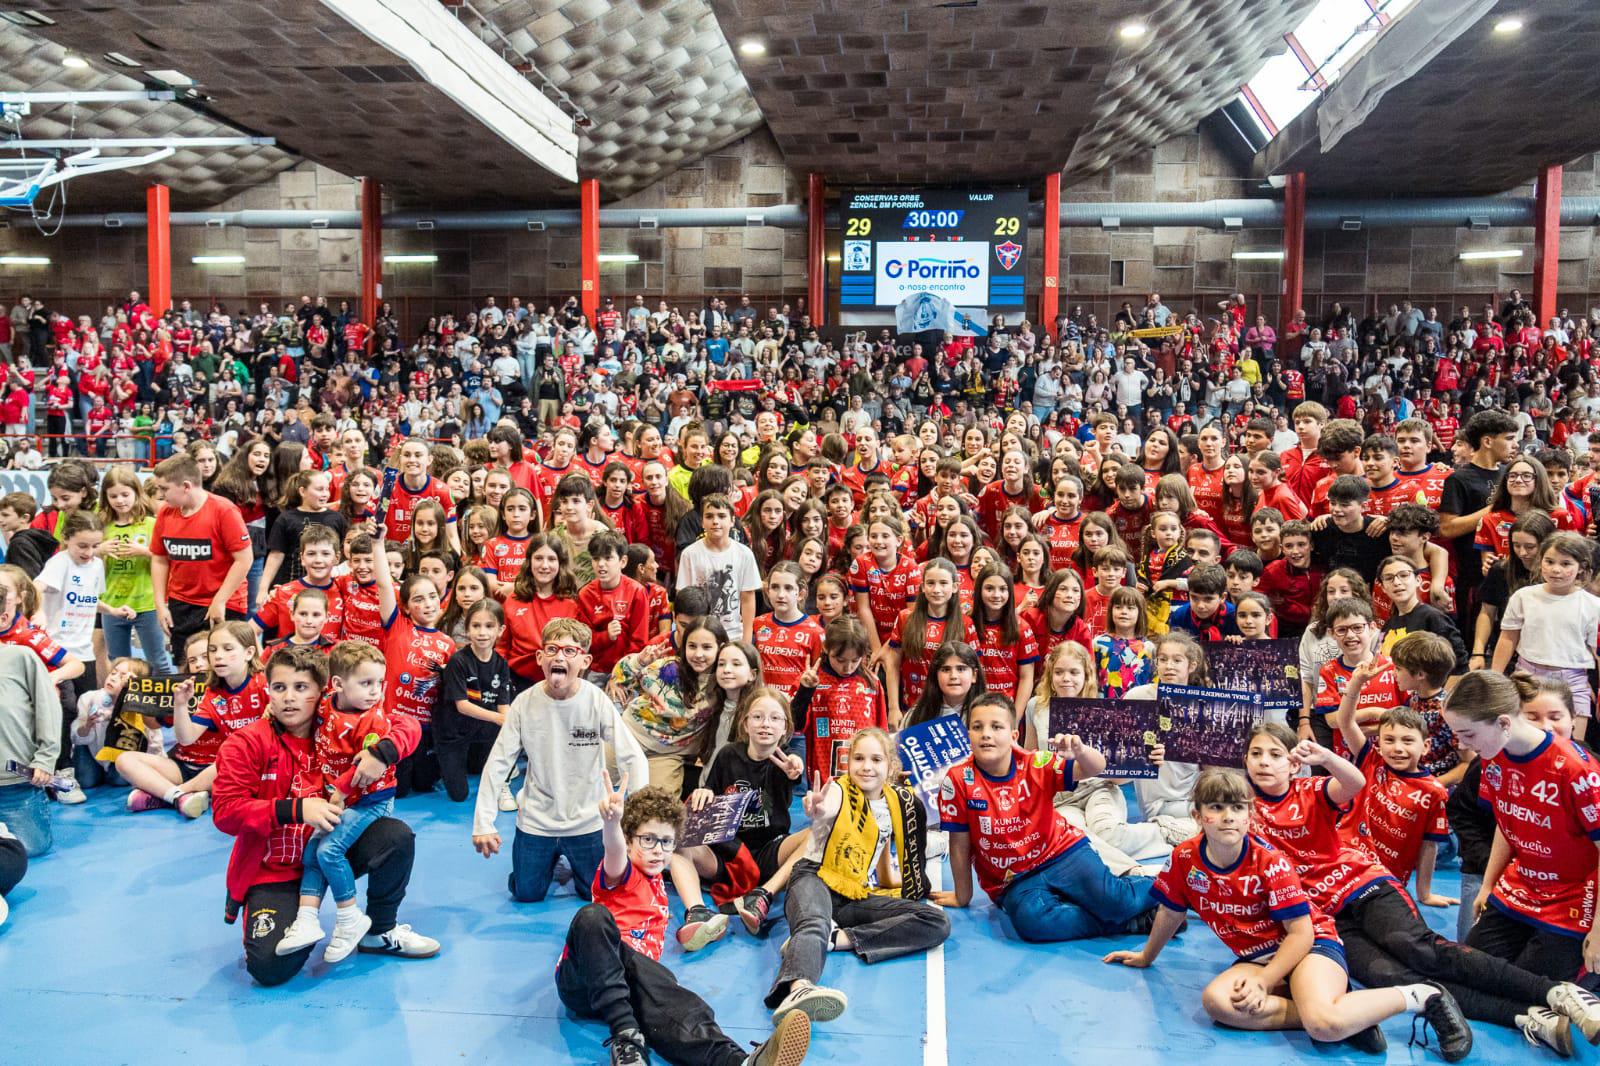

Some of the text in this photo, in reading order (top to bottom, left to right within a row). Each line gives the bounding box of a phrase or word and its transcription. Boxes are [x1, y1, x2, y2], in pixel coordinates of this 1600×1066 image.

[850, 201, 878, 209] ZENDAL
[891, 200, 924, 208] PORRIÑO
[846, 218, 872, 236] 29
[909, 211, 959, 227] 30:00
[994, 217, 1020, 236] 29
[164, 539, 211, 560] Kempa
[795, 631, 811, 646] 91
[763, 645, 804, 657] RUBENSA
[250, 693, 261, 709] 5
[863, 696, 873, 718] 3
[831, 719, 856, 728] XUNTA
[1407, 789, 1432, 810] 46
[1530, 779, 1560, 807] 42
[993, 816, 1022, 826] XUNTA
[1288, 803, 1304, 821] 2
[1497, 799, 1553, 830] RUBENSA
[994, 826, 1006, 835] DE
[1238, 874, 1265, 897] 72
